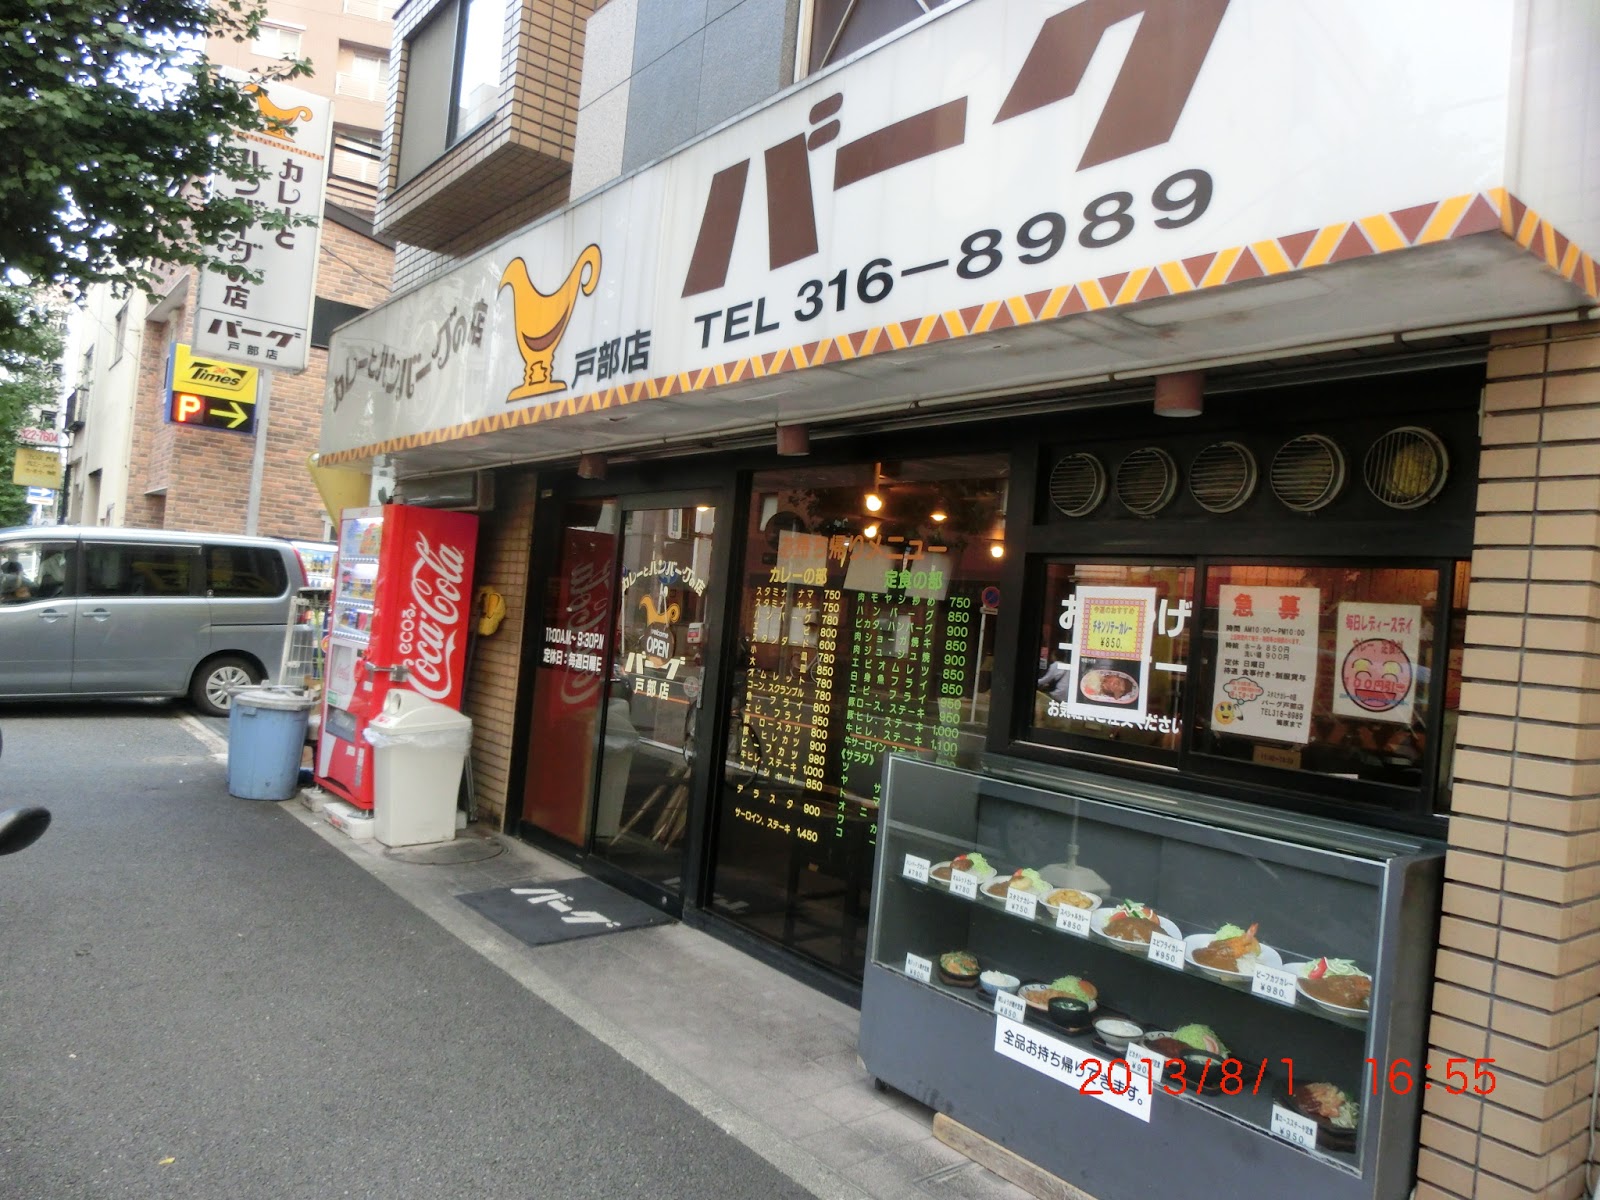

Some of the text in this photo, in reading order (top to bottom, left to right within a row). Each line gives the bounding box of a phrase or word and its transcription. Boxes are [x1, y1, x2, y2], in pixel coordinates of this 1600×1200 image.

[695, 295, 780, 349] TEL
[207, 318, 302, 348] バーグ
[227, 341, 279, 360] 戸部店
[333, 298, 489, 412] カレーとハンバーグの店
[571, 329, 652, 390] 戸部店
[189, 362, 242, 387] Times
[178, 395, 201, 422] P
[769, 567, 828, 585] カレーの部
[883, 569, 944, 590] 定食の部
[756, 586, 787, 597] スタミナ
[824, 590, 841, 600] 750
[755, 598, 786, 609] スタミナ
[823, 602, 840, 613] 750
[949, 597, 971, 609] 750
[1233, 593, 1301, 620] 急募
[402, 530, 465, 699] Coca-Cola
[753, 610, 839, 626] ハンバーグ 780
[856, 605, 969, 623] ハンバーグ 850
[820, 627, 837, 639] 800
[946, 626, 968, 637] 900
[646, 636, 670, 659] OPEN
[751, 633, 836, 651] スタンダード 600
[945, 640, 967, 652] 850
[625, 651, 686, 680] バーグ
[818, 653, 835, 664] 780
[943, 654, 966, 667] 900
[1243, 660, 1266, 669] 日曜日
[747, 668, 833, 689] オムレット 780
[816, 665, 834, 677] 850
[851, 658, 965, 681] エビオムレツ 850
[633, 677, 670, 700] 戸部店
[850, 671, 963, 695] 白身魚フライ 850
[814, 690, 832, 701] 780
[940, 697, 962, 710] 950
[813, 702, 830, 715] 800
[939, 711, 961, 724] 950
[812, 715, 829, 727] 950
[810, 727, 828, 740] 800
[741, 737, 826, 765] ビーフカツ 980
[809, 740, 827, 752] 900
[740, 761, 823, 791] スペシャル 850
[803, 803, 820, 816] 900
[510, 888, 621, 928] バーグ
[1003, 1029, 1144, 1106] 全品お持ち帰りできます。
